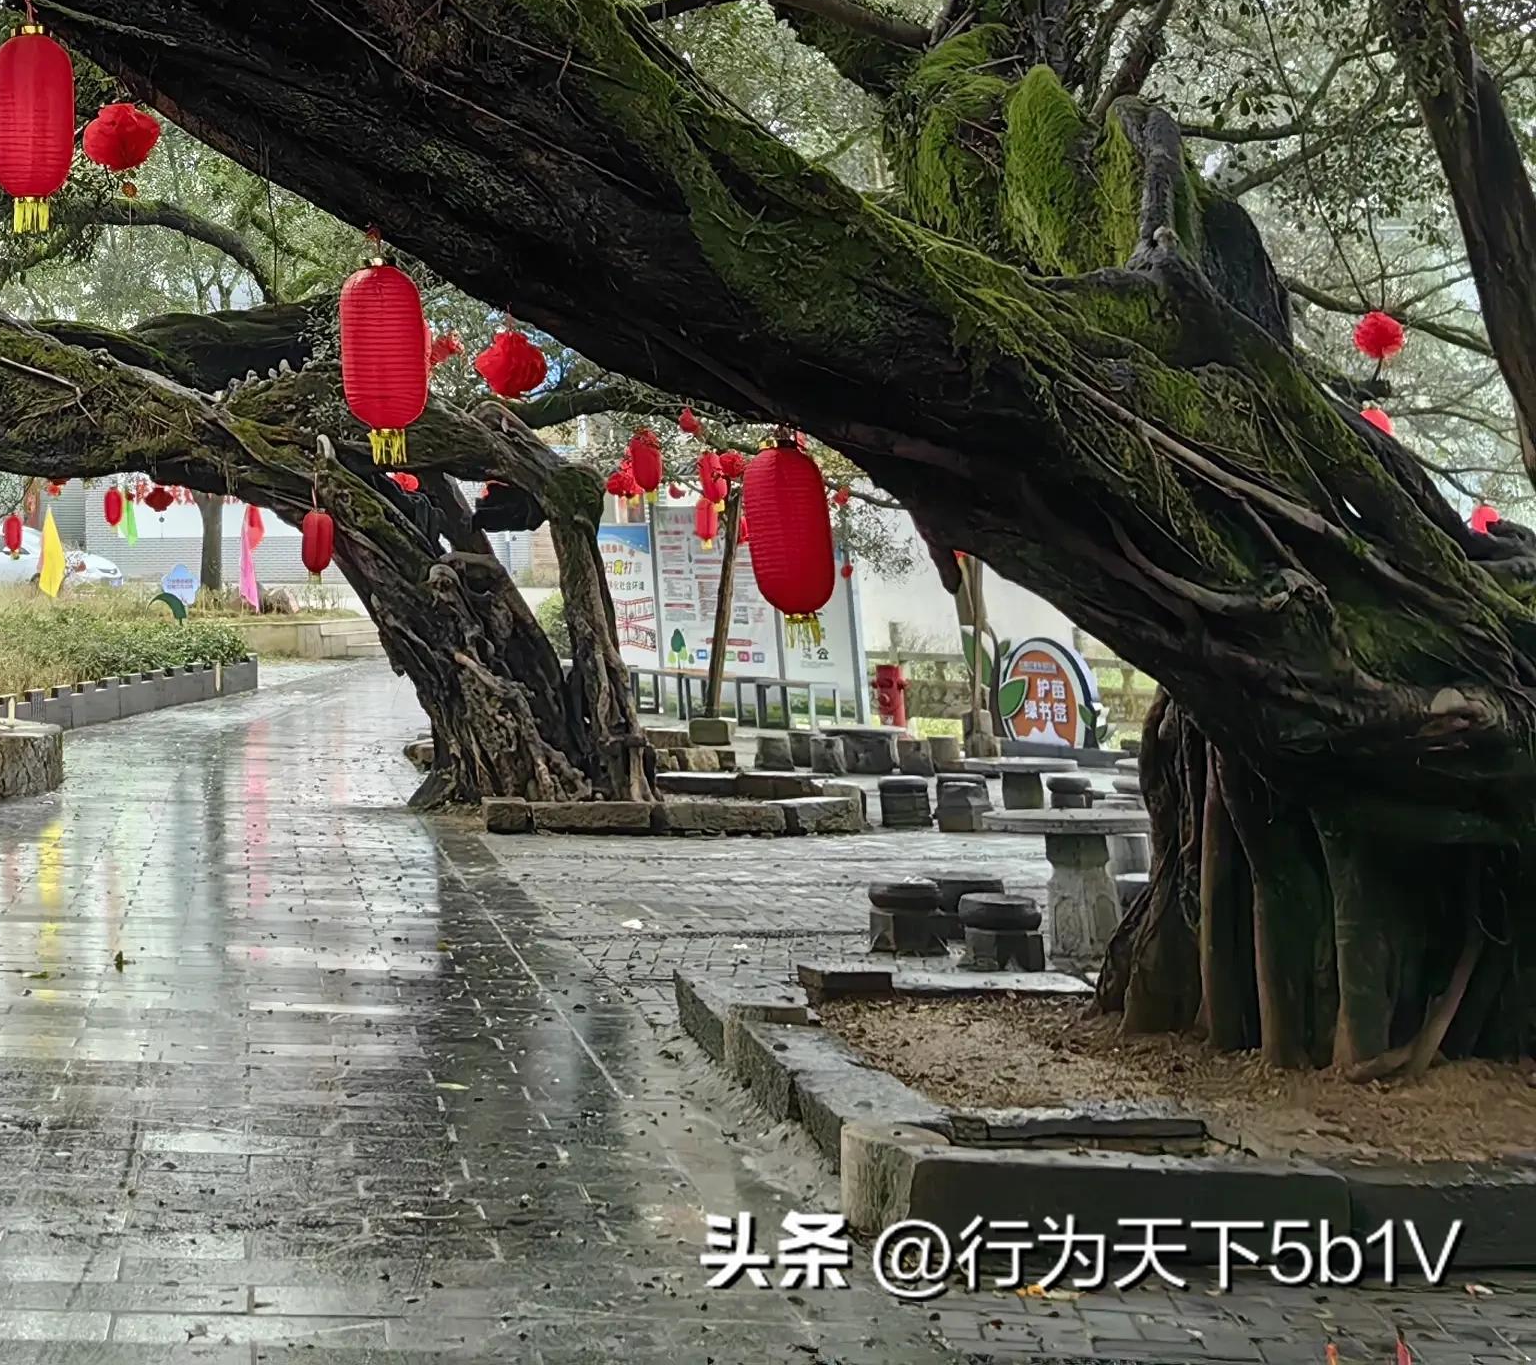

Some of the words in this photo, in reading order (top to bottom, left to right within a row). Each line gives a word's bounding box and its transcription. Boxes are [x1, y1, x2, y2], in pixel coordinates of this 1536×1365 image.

[1036, 677, 1066, 700] 护苗
[1024, 699, 1068, 723] 绿书签
